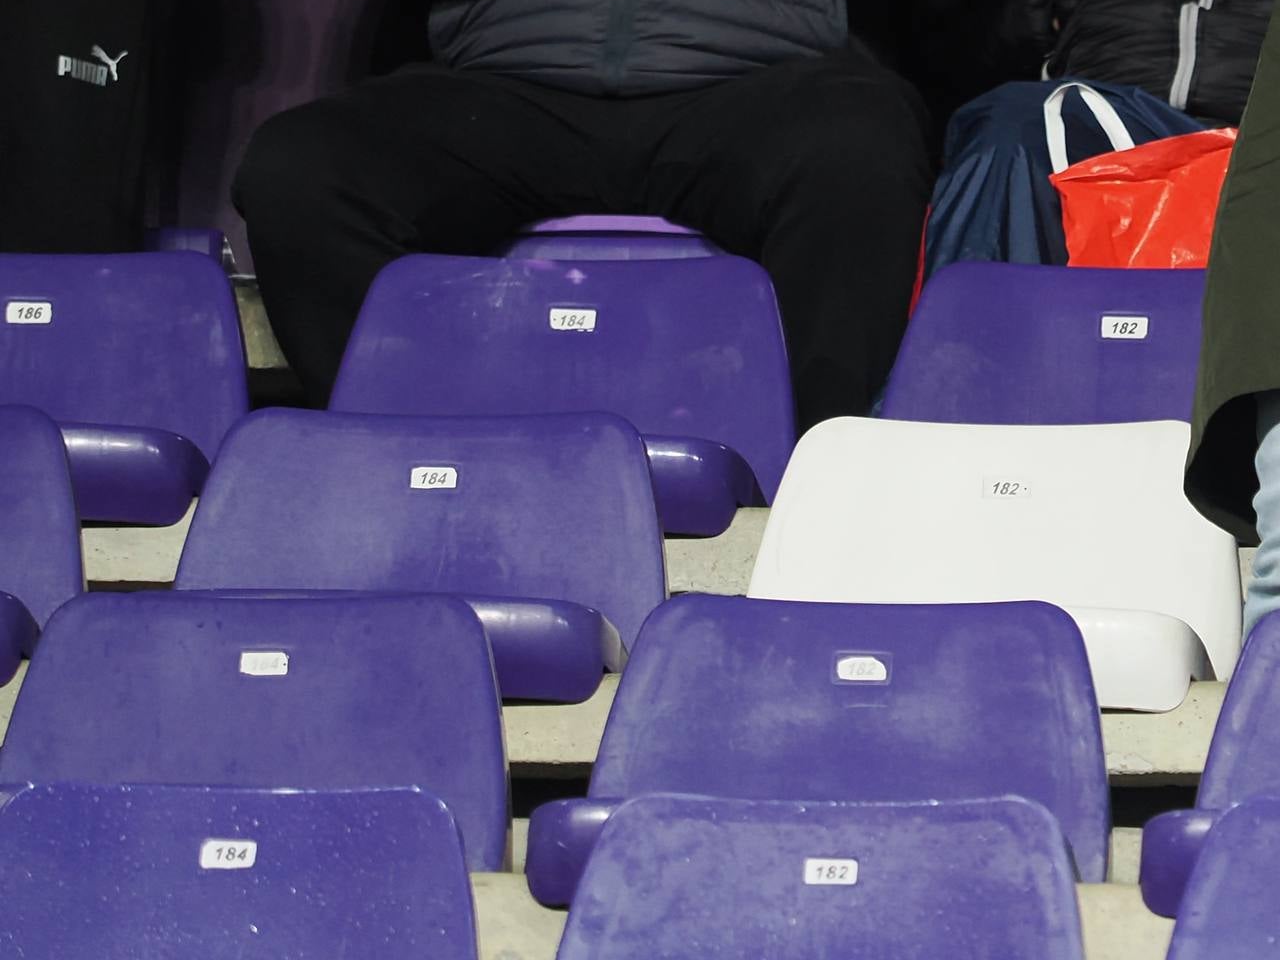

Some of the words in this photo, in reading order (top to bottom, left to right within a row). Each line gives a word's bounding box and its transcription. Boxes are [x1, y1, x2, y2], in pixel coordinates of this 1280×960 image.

[57, 54, 108, 86] PUMA
[16, 306, 43, 320] 186
[559, 314, 586, 328] 184
[1110, 322, 1139, 335] 182
[420, 472, 448, 486] 184
[991, 481, 1019, 496] 182
[215, 847, 249, 862] 184
[815, 865, 849, 880] 182
